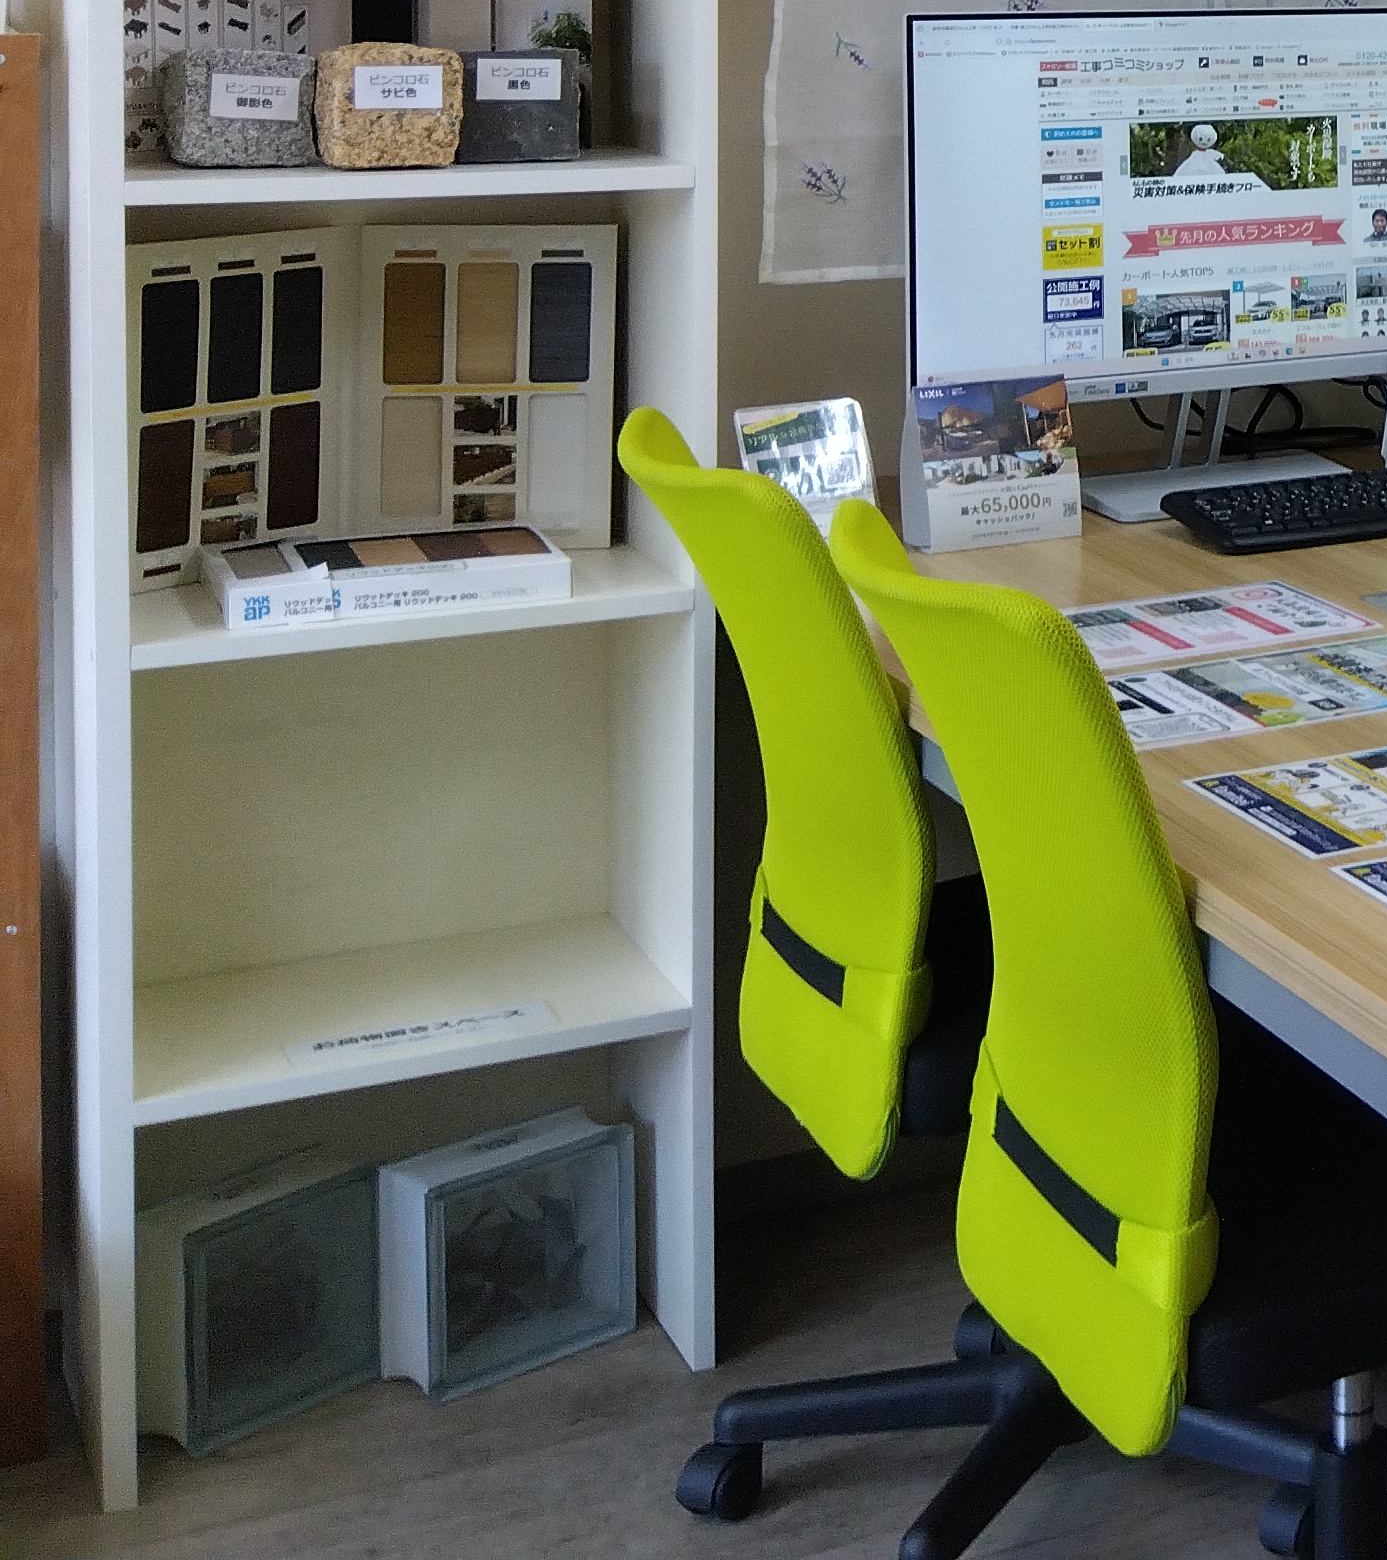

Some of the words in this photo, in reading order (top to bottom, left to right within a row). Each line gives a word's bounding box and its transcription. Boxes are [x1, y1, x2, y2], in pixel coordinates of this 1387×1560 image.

[1080, 57, 1185, 72] 工事コミコミショップ
[491, 65, 549, 79] ピンコロ石
[369, 73, 429, 86] ピンコロ石
[225, 82, 287, 97] ピンコロ石
[381, 86, 417, 99] サビ色
[236, 95, 273, 109] 御影色
[1133, 182, 1262, 199] 災害対策&保険手続きフロー
[1180, 220, 1315, 244] 先月の人気ランキング
[1059, 237, 1100, 250] セット割
[1122, 268, 1214, 281] カーポート人気TOP5
[1047, 280, 1100, 294] 公開施工例
[919, 389, 944, 399] LIXIL
[244, 596, 270, 607] YKK
[244, 605, 270, 621] ap
